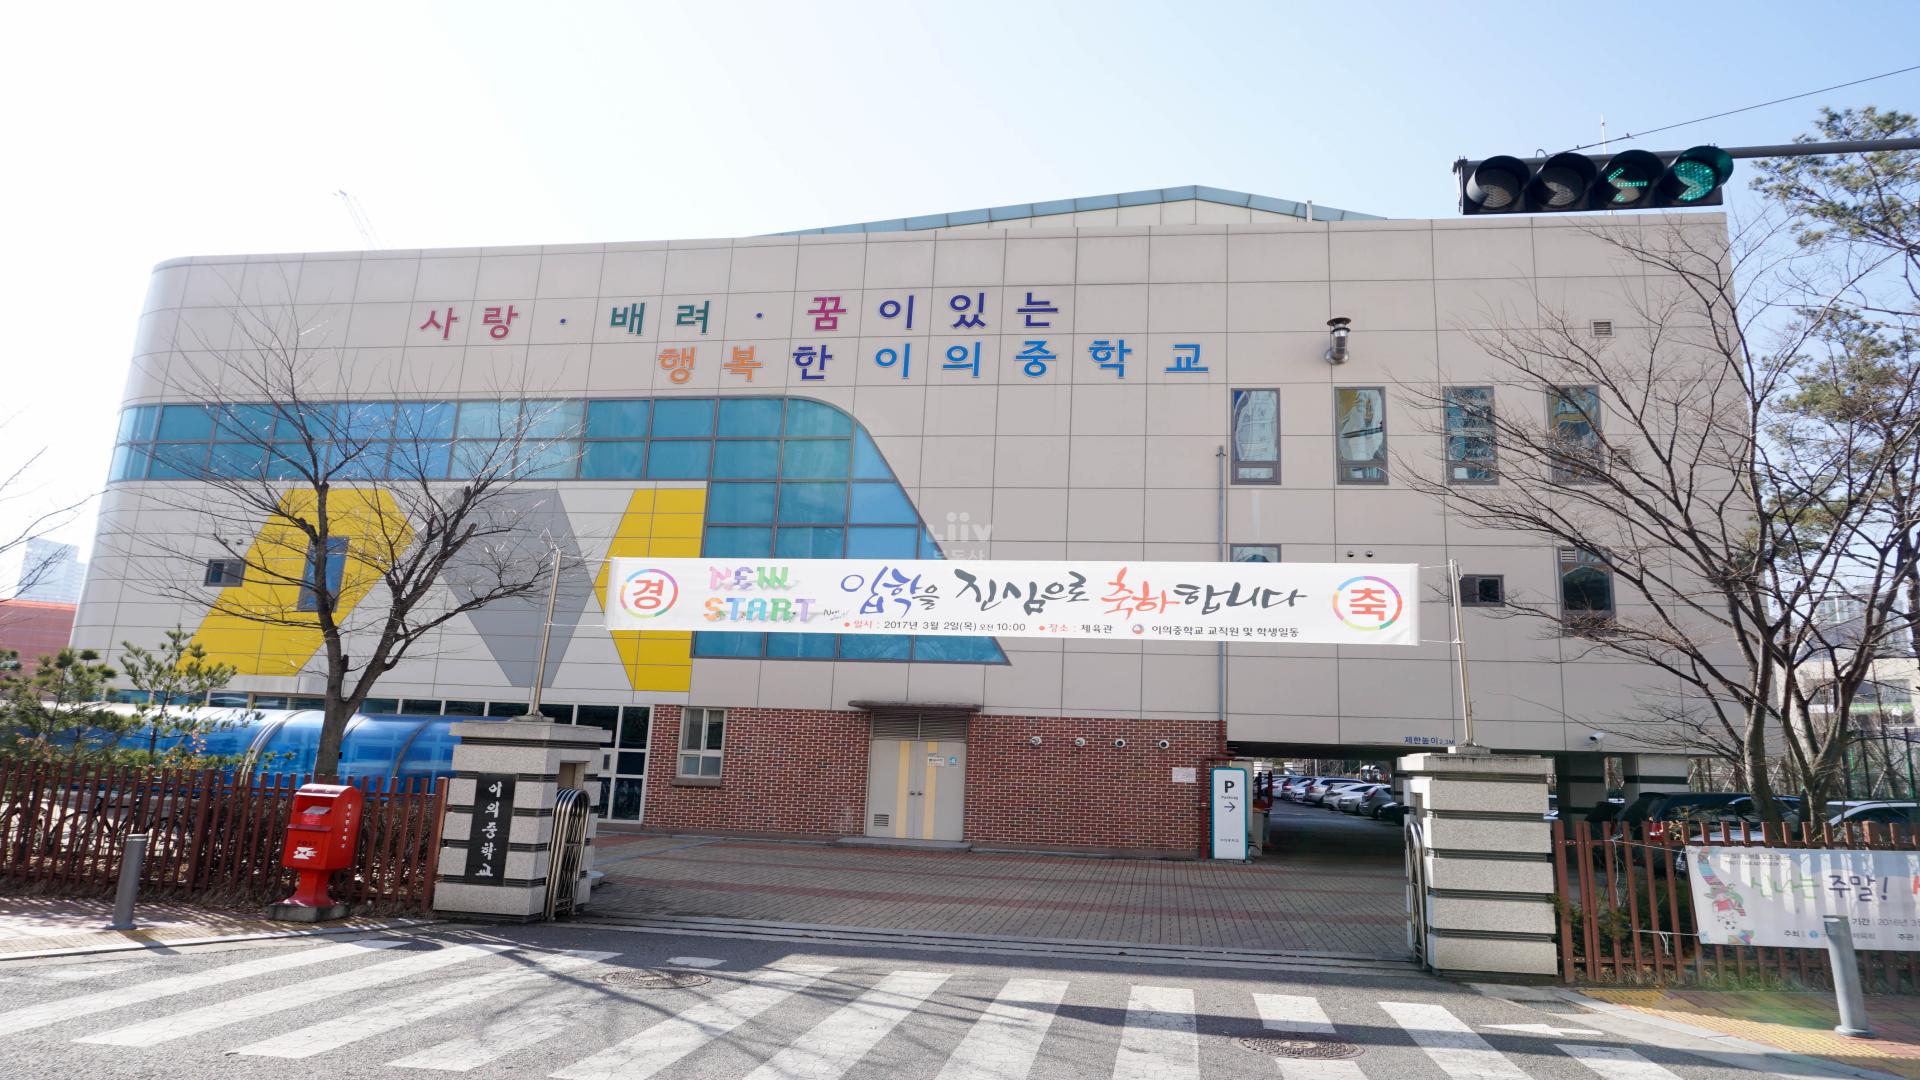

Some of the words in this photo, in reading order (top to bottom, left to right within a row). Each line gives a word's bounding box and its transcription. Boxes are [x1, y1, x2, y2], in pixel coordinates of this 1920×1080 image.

[420, 305, 518, 340] 사랑
[610, 301, 709, 336] 배려
[807, 294, 915, 331] 꿈이
[949, 292, 1059, 329] 있는
[658, 343, 833, 384] 행복한
[875, 339, 1209, 379] 이의중학교
[709, 566, 788, 590] NEW
[633, 579, 663, 610] 경
[840, 565, 940, 618] 입학을
[954, 568, 1089, 616] 진심으로
[1101, 566, 1308, 620] 축하합니다
[1349, 587, 1387, 621] 축
[704, 597, 816, 623] START
[884, 621, 918, 631] 2017년
[922, 622, 939, 631] 3월
[943, 622, 977, 632] 2일(목)
[979, 624, 994, 632] 오전
[997, 623, 1026, 632] 10:00
[1081, 624, 1113, 634] 체육관
[1151, 625, 1204, 636] 이의중학교
[1207, 625, 1240, 637] 교직원
[1243, 627, 1254, 637] 및
[1257, 626, 1300, 638] 학생일동
[1404, 736, 1438, 745] 제한높이
[1224, 780, 1235, 793] P
[475, 781, 503, 878] 이의중학교
[1828, 874, 1889, 902] 주말!
